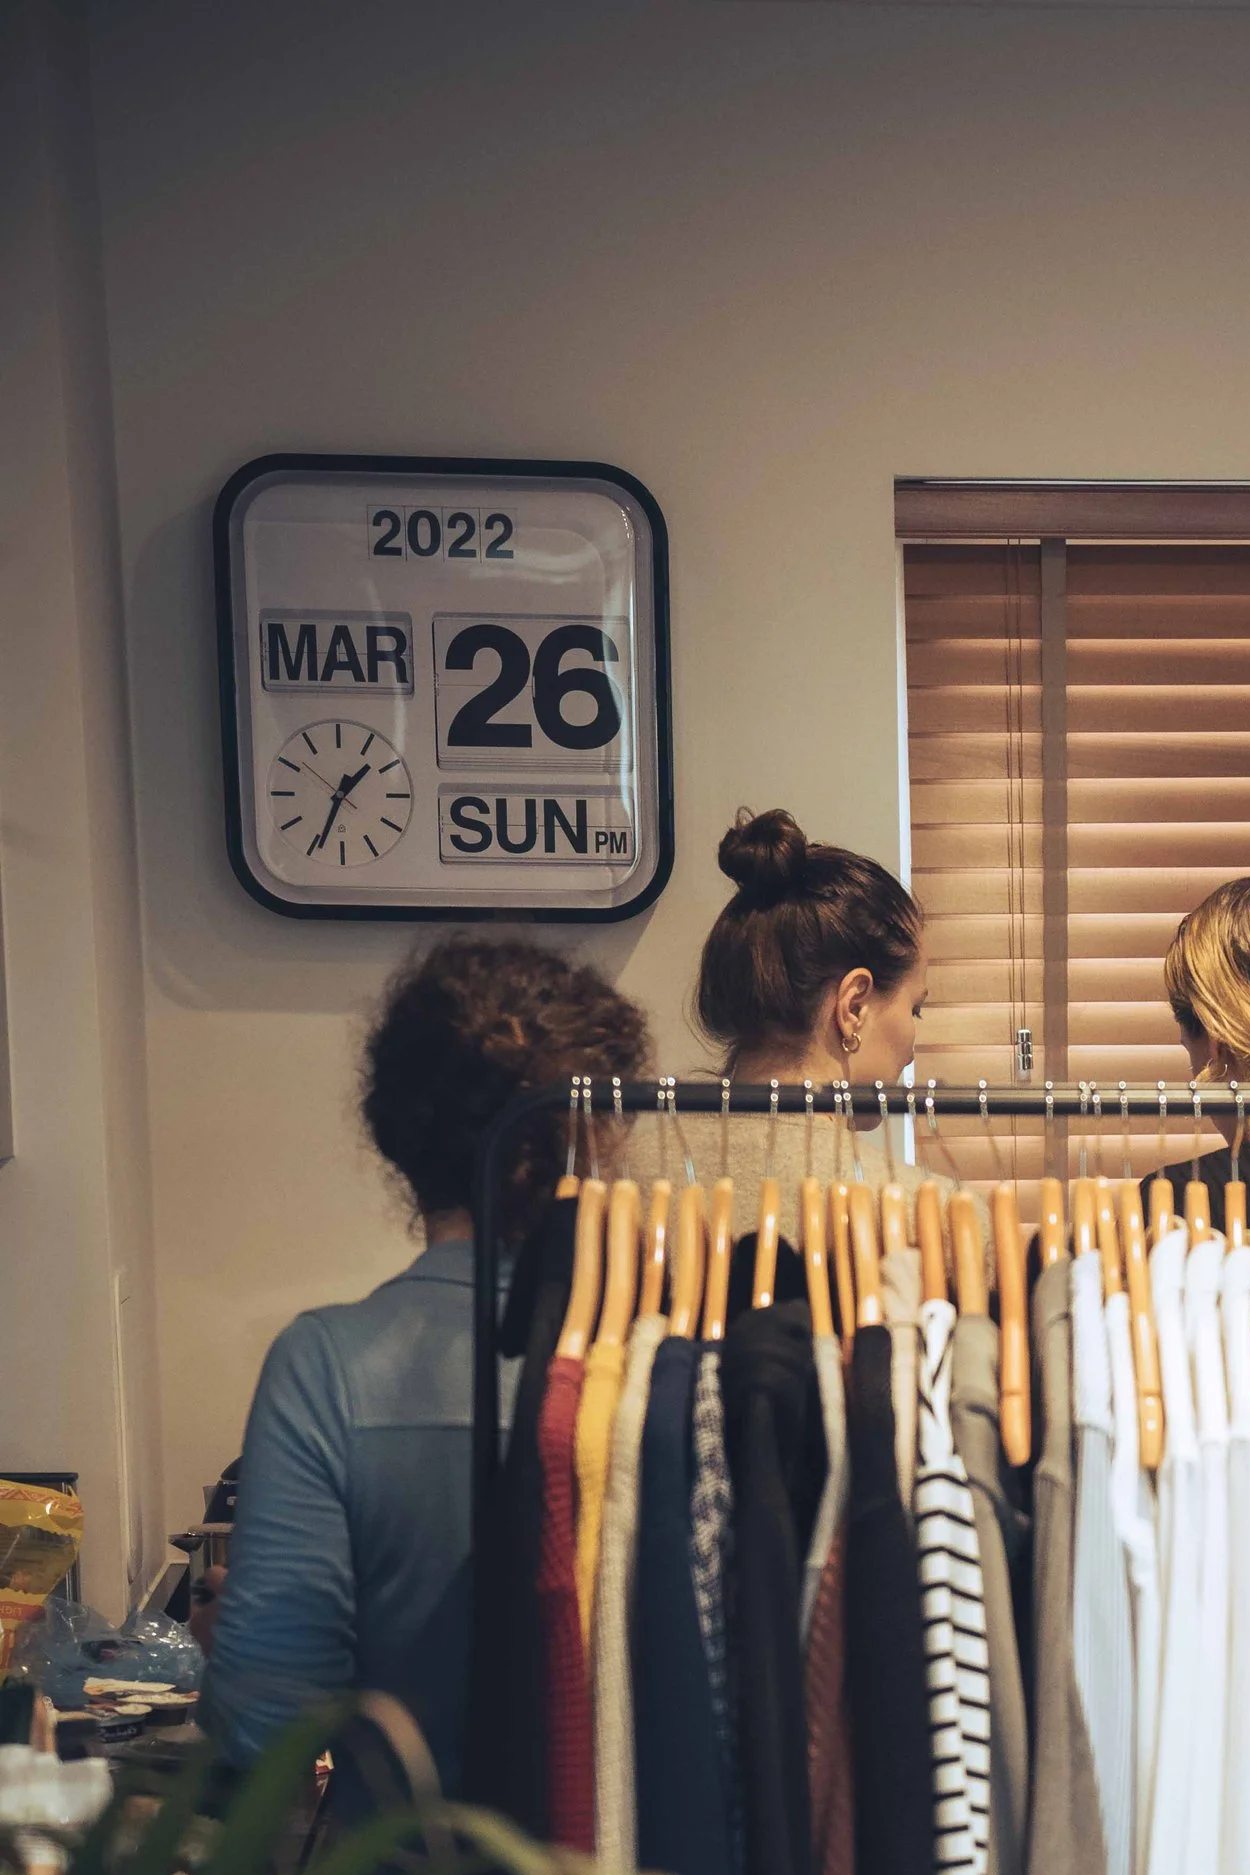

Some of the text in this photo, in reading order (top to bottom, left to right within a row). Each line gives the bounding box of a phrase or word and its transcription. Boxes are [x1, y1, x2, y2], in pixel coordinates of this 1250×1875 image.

[372, 509, 514, 559] 2022
[267, 622, 409, 683] MAR
[445, 623, 623, 750] 26
[450, 796, 627, 853] SUN PM
